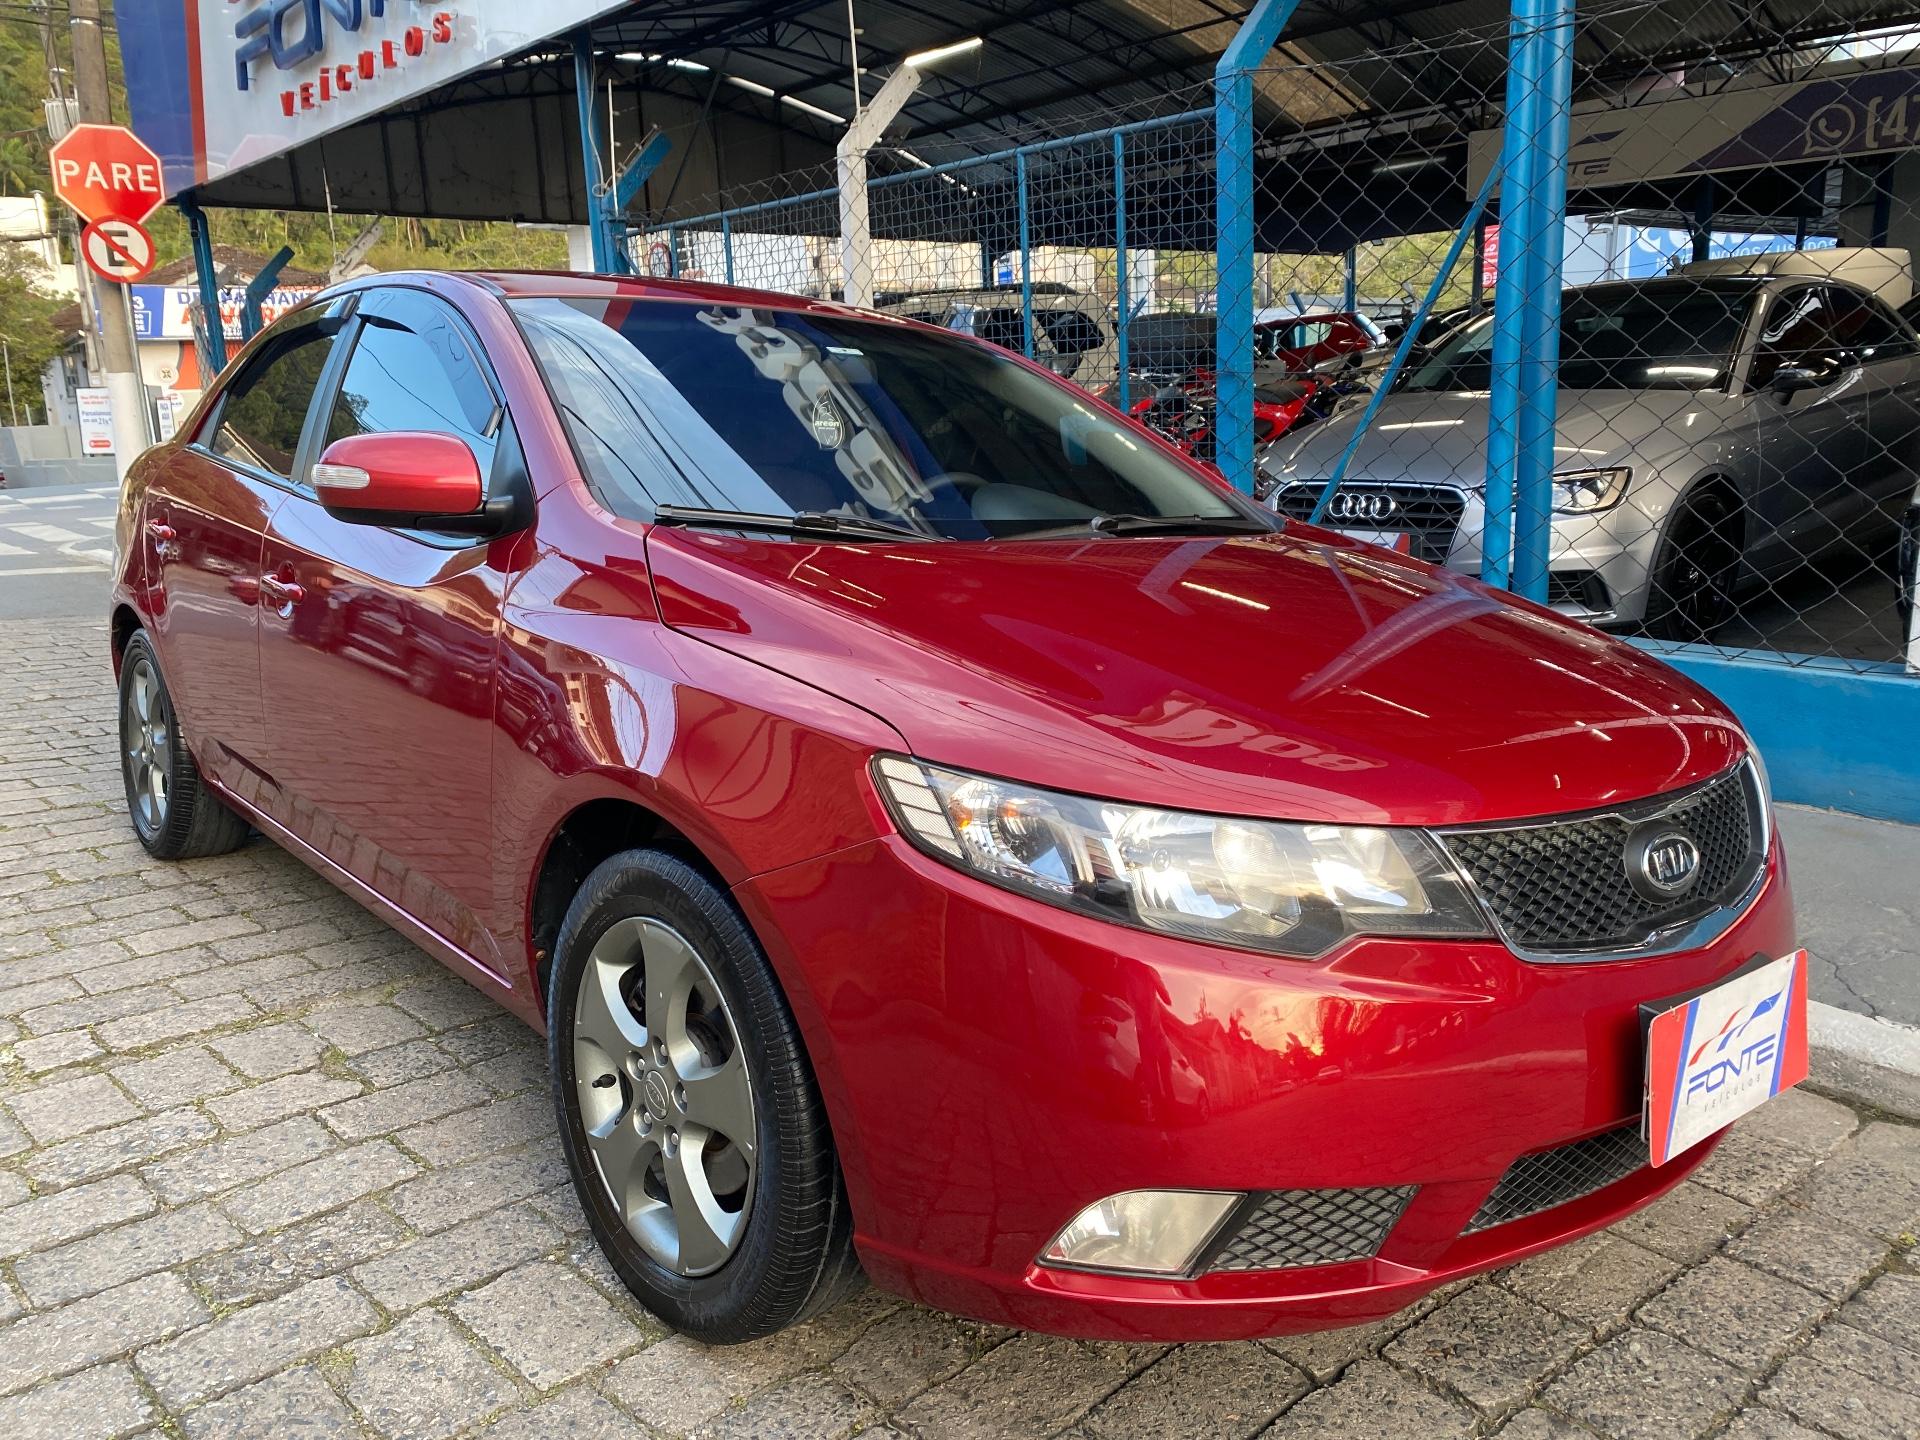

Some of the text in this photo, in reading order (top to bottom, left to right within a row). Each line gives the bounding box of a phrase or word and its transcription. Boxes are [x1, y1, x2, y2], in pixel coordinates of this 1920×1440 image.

[57, 159, 158, 193] PARE
[1651, 843, 1692, 880] KIA
[1686, 1033, 1777, 1105] FONTE
